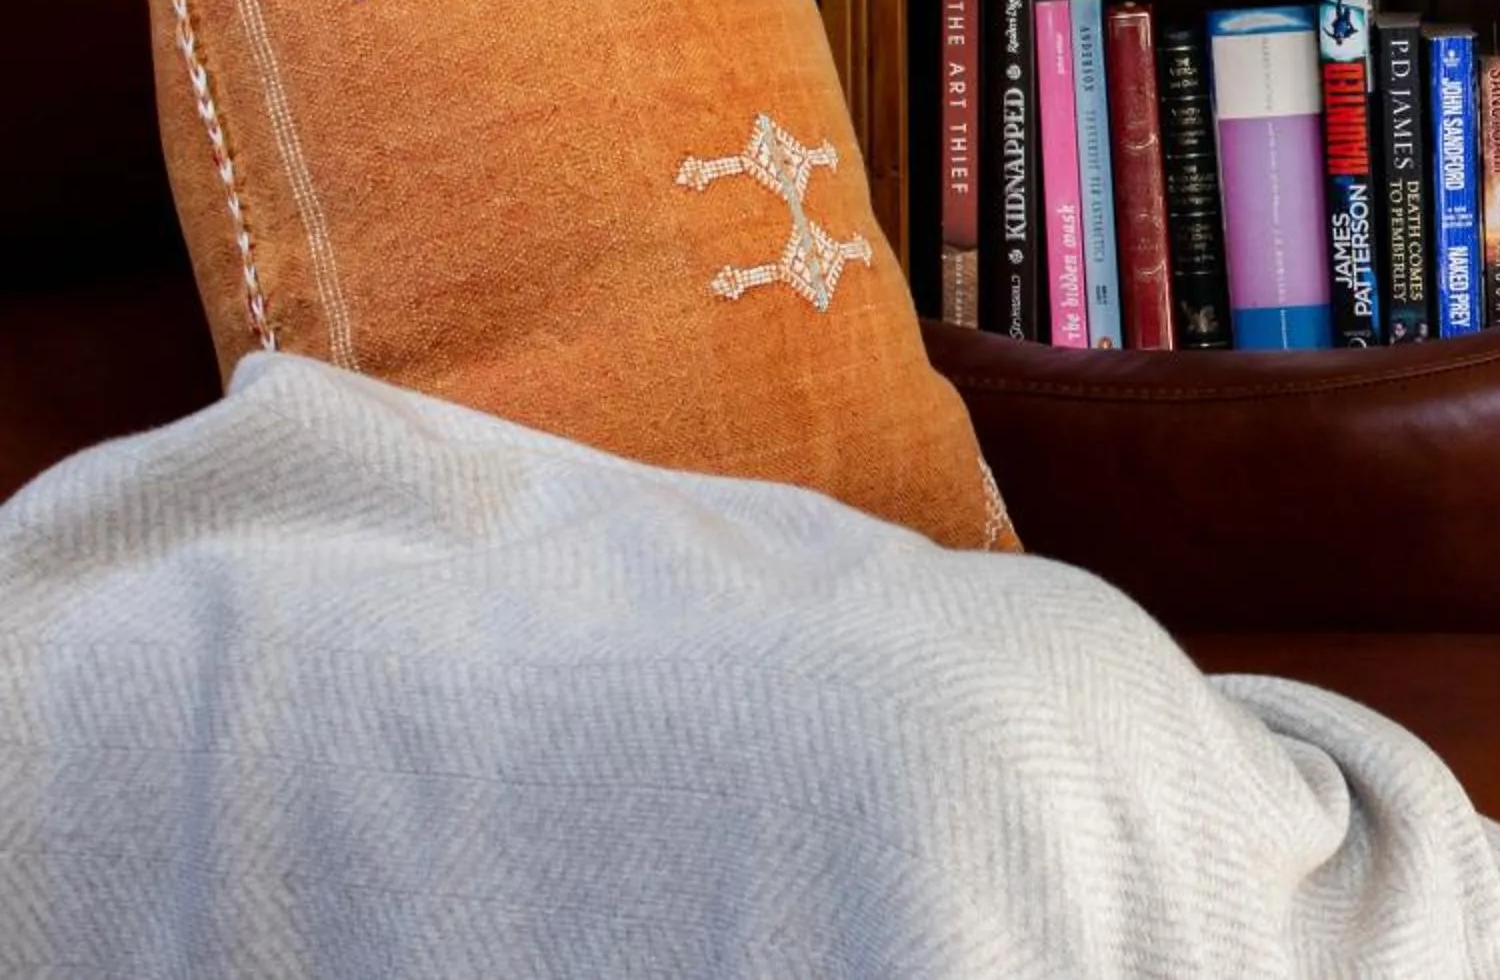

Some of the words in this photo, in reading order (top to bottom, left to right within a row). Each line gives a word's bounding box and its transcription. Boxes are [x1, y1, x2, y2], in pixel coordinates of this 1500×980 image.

[947, 2, 965, 46] THE
[949, 63, 967, 108] ART
[1391, 40, 1408, 81] P.D.
[1323, 63, 1368, 175] HAUNTED
[1440, 77, 1461, 116] JOHN
[950, 123, 968, 195] THIEF
[1390, 89, 1414, 170] JAMES
[1443, 117, 1465, 191] SANDFORD
[1003, 88, 1026, 242] KIDNAPPED
[1389, 179, 1403, 204] TO
[1407, 180, 1422, 238] DEATH
[1333, 214, 1350, 288] JAMES
[1348, 185, 1372, 317] PATTERSON
[1390, 207, 1407, 302] PEMBERLEY
[1408, 241, 1423, 301] COMES
[1447, 246, 1469, 293] NAKED
[1449, 294, 1470, 327] PREY
